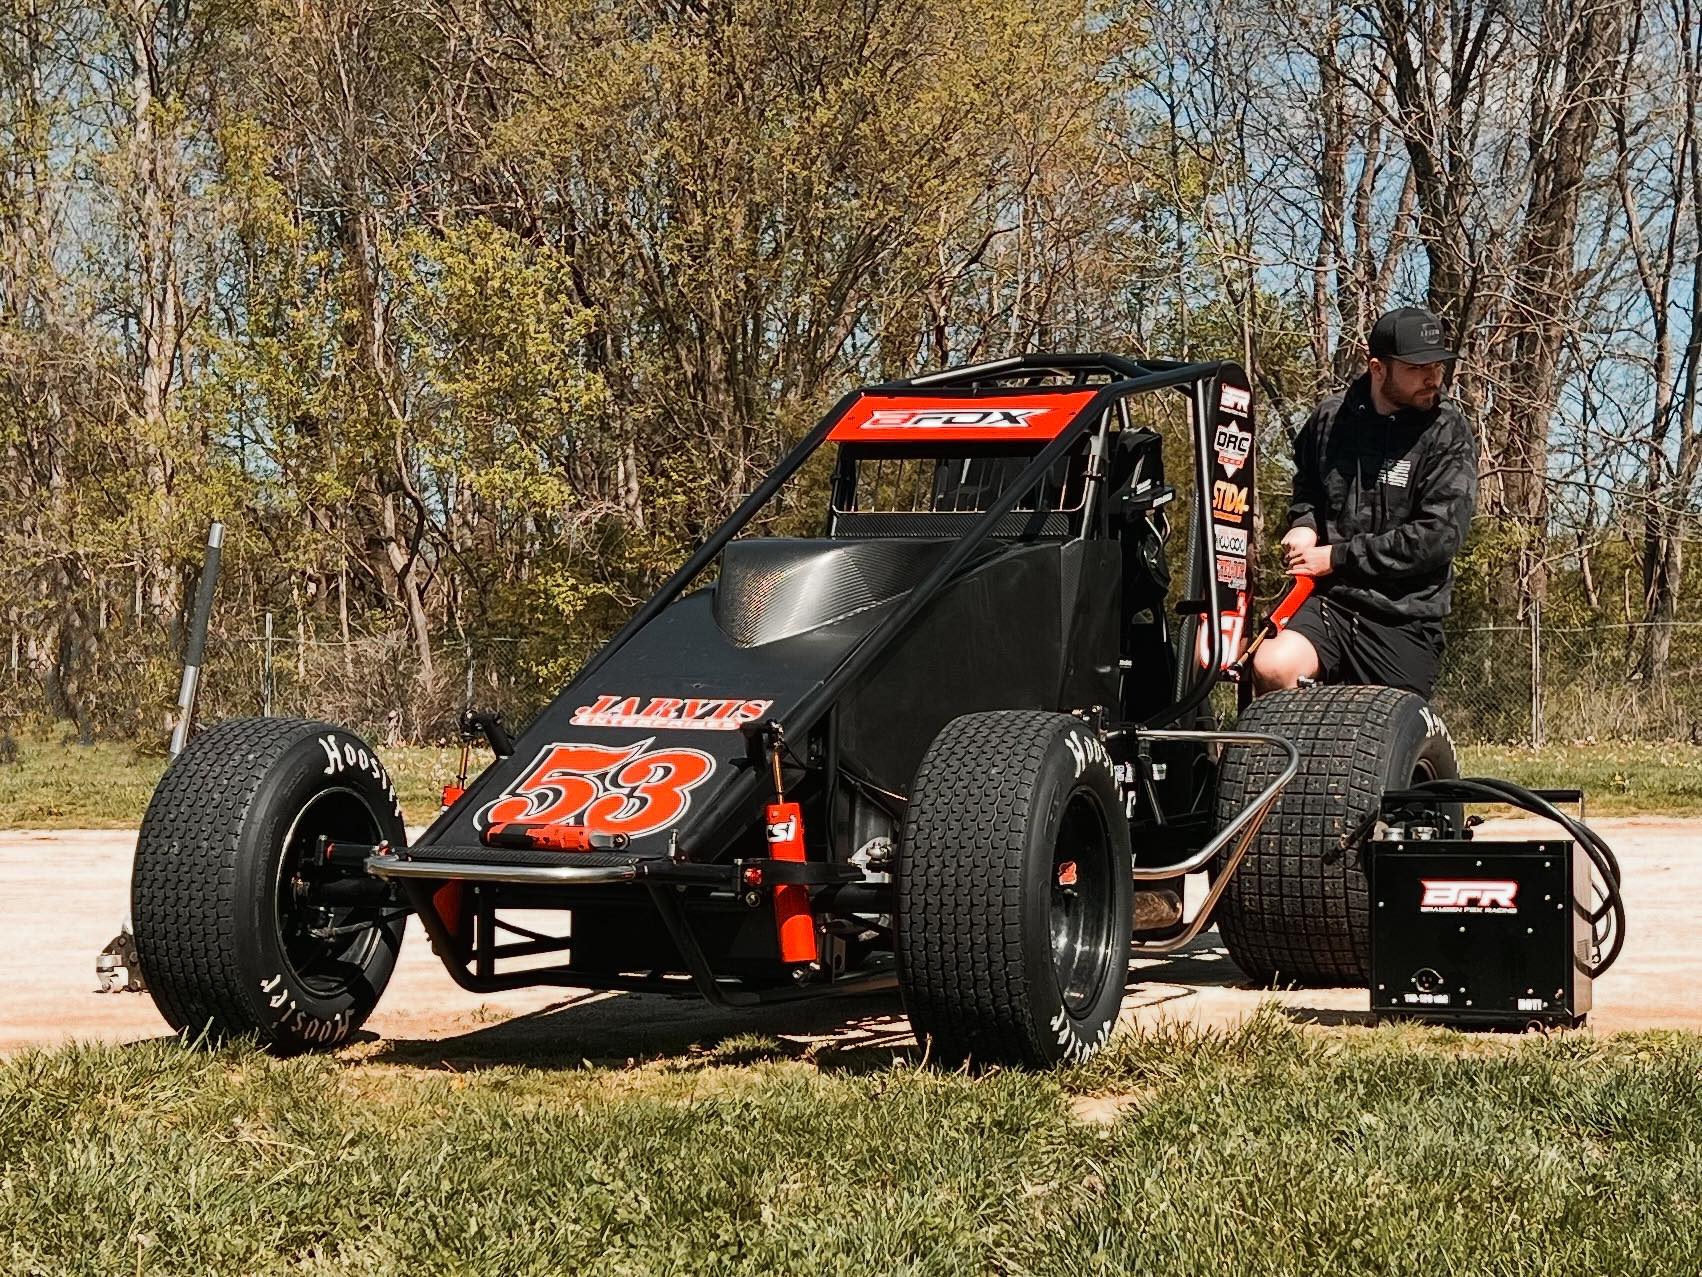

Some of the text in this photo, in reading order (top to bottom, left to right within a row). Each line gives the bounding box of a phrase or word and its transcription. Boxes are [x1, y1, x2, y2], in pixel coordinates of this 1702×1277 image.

[574, 695, 774, 723] JARVIS
[473, 736, 717, 839] 53
[1420, 880, 1518, 907] BFR
